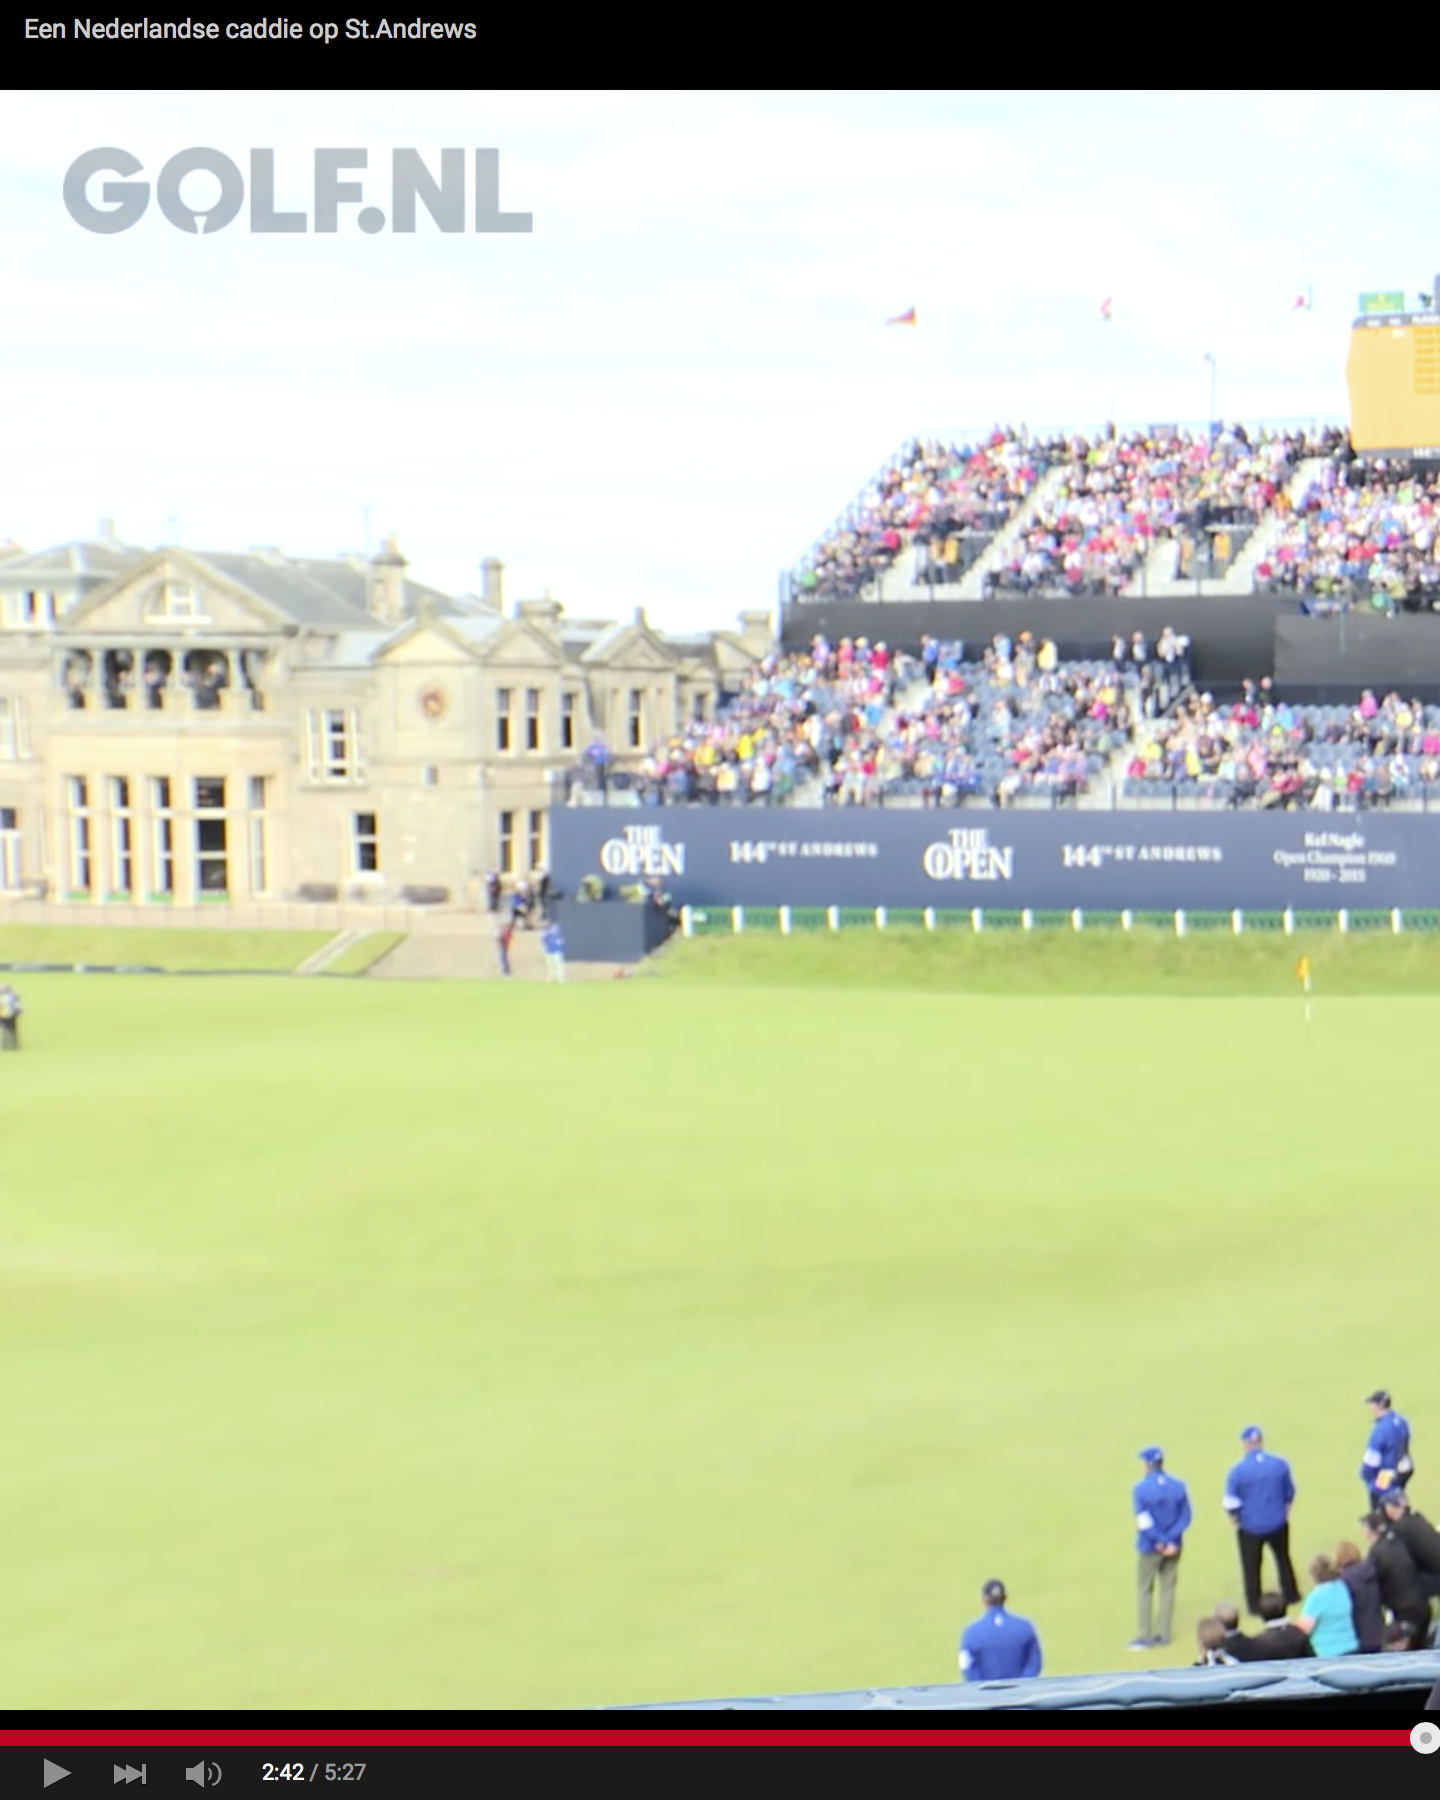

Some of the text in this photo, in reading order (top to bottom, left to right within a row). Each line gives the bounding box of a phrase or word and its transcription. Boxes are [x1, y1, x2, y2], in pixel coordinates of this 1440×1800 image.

[624, 824, 662, 842] THE
[948, 828, 988, 847] THE
[600, 837, 686, 877] OPEN
[800, 841, 878, 858] ANDREWS
[1114, 845, 1135, 861] ST
[1138, 845, 1223, 863] ANDREWS
[923, 841, 1014, 881] OPEN
